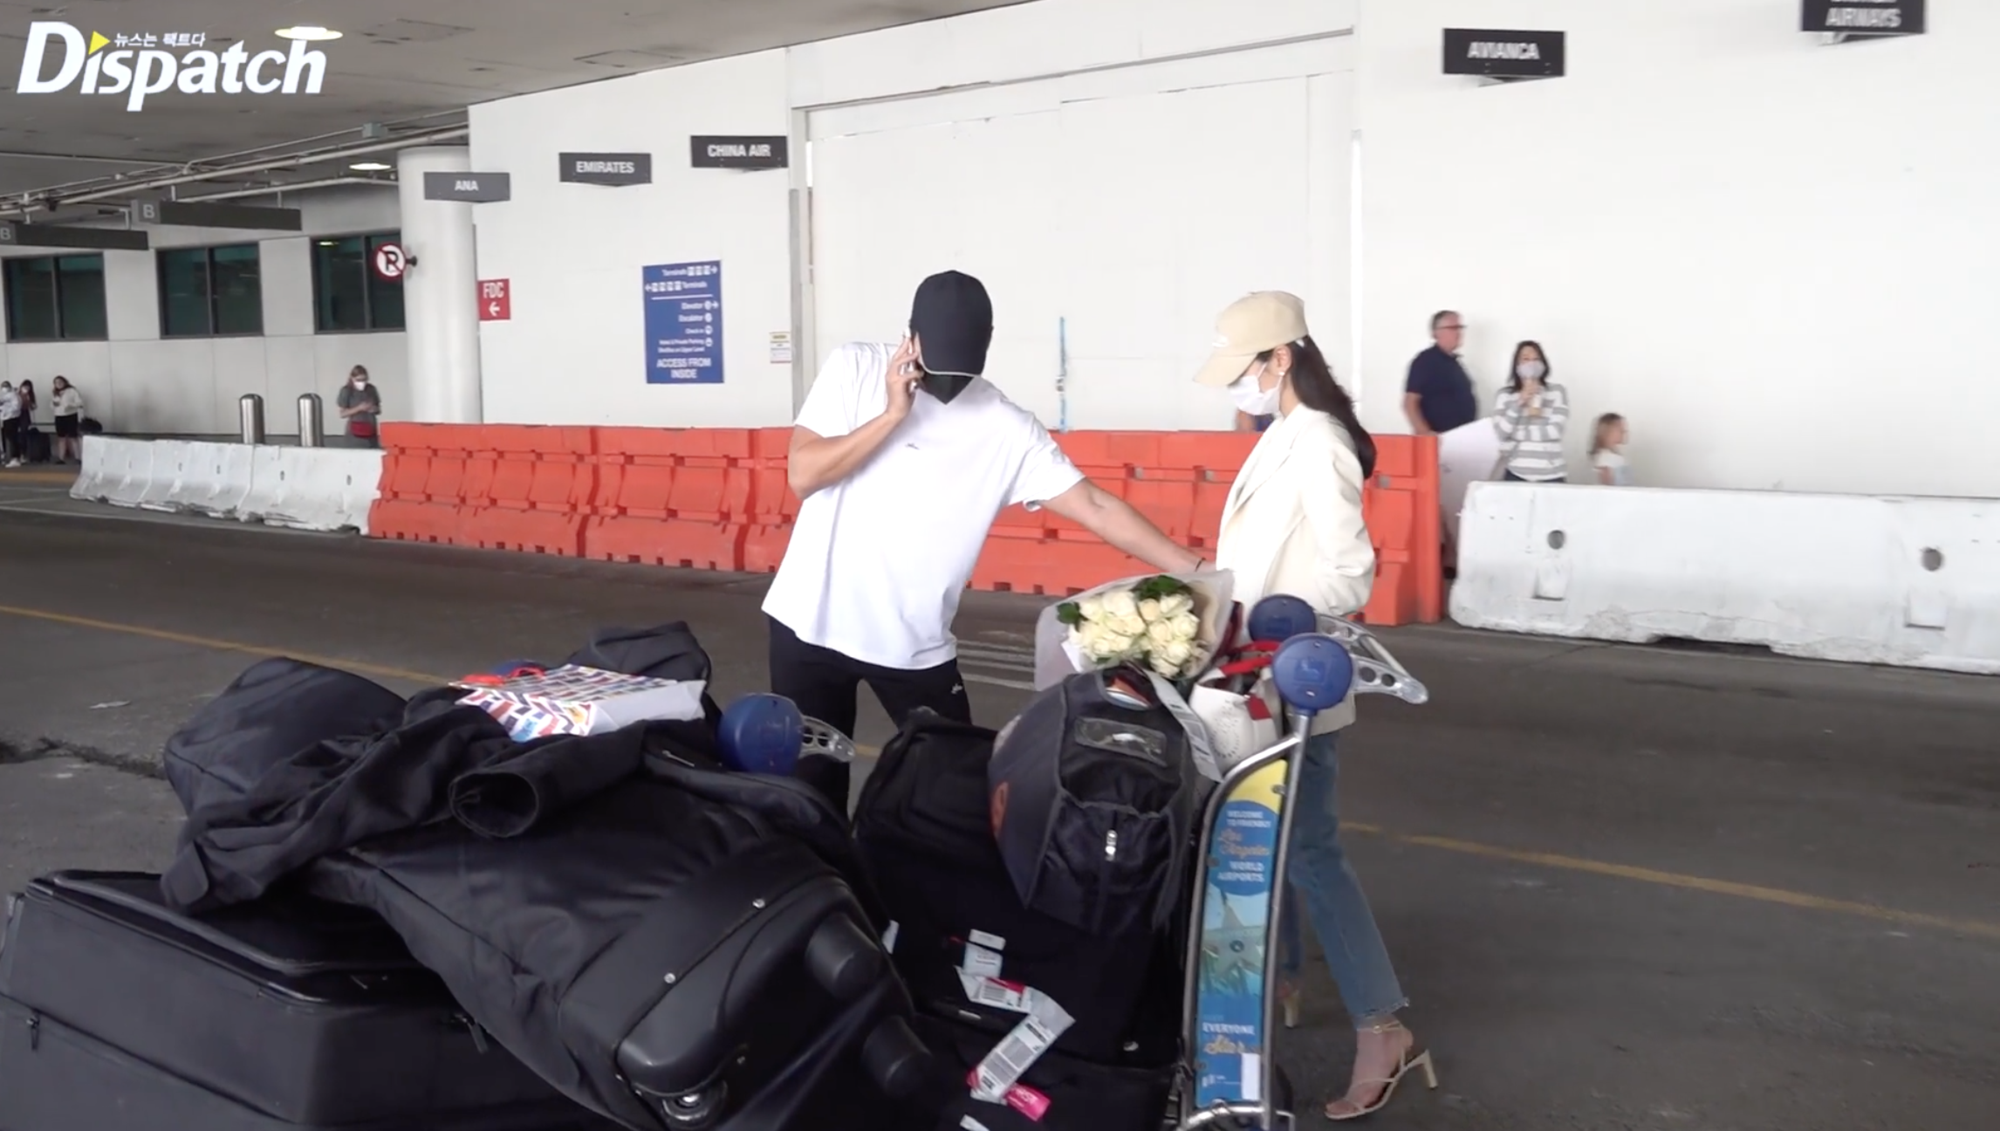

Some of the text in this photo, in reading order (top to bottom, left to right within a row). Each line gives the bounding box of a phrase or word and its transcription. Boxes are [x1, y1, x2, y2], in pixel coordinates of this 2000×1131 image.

[1825, 7, 1902, 27] AIRWAYS
[1467, 41, 1540, 60] AVIANCA
[708, 144, 771, 157] CHINA AIR
[576, 161, 634, 174] EMIRATES
[455, 180, 478, 191] ANA
[143, 204, 155, 219] B
[0, 228, 11, 240] B
[483, 282, 504, 299] FDC
[657, 358, 711, 368] ACCESS FROM
[671, 369, 697, 378] INSIDE
[1227, 810, 1263, 818] WELCOME
[1229, 861, 1264, 871] WORLD
[1218, 872, 1265, 882] AIRPORTS
[1202, 1022, 1255, 1035] EVERYONE
